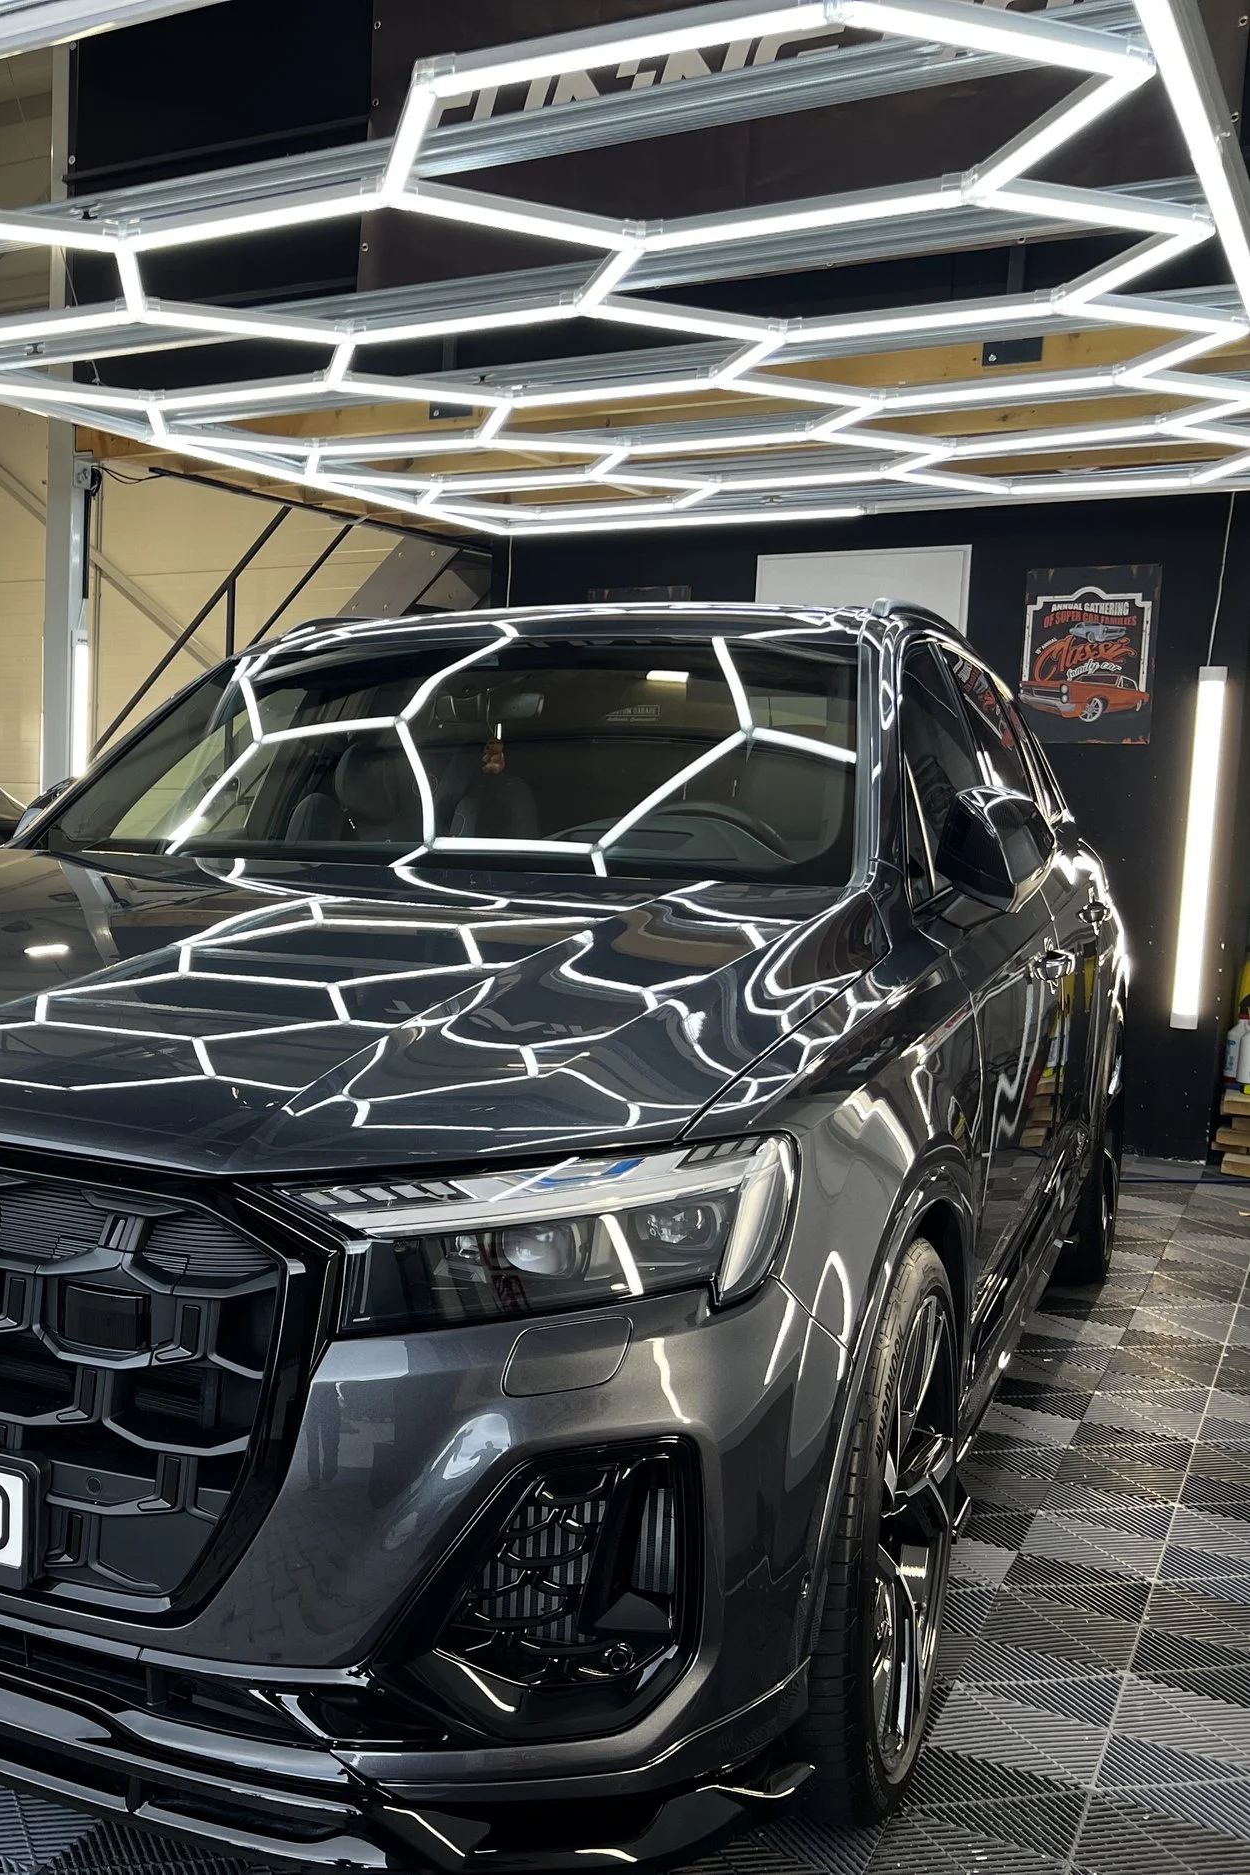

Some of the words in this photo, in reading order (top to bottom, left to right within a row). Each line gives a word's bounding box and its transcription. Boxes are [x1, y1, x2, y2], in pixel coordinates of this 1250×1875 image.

[1051, 603, 1083, 613] ANNUAL
[1084, 602, 1130, 616] GATHERING
[1043, 613, 1055, 628] OF
[1055, 611, 1081, 625] SUPER
[1082, 612, 1099, 623] CAR
[1100, 615, 1137, 626] FAMILIES
[1066, 658, 1100, 681] family
[1100, 661, 1123, 672] car
